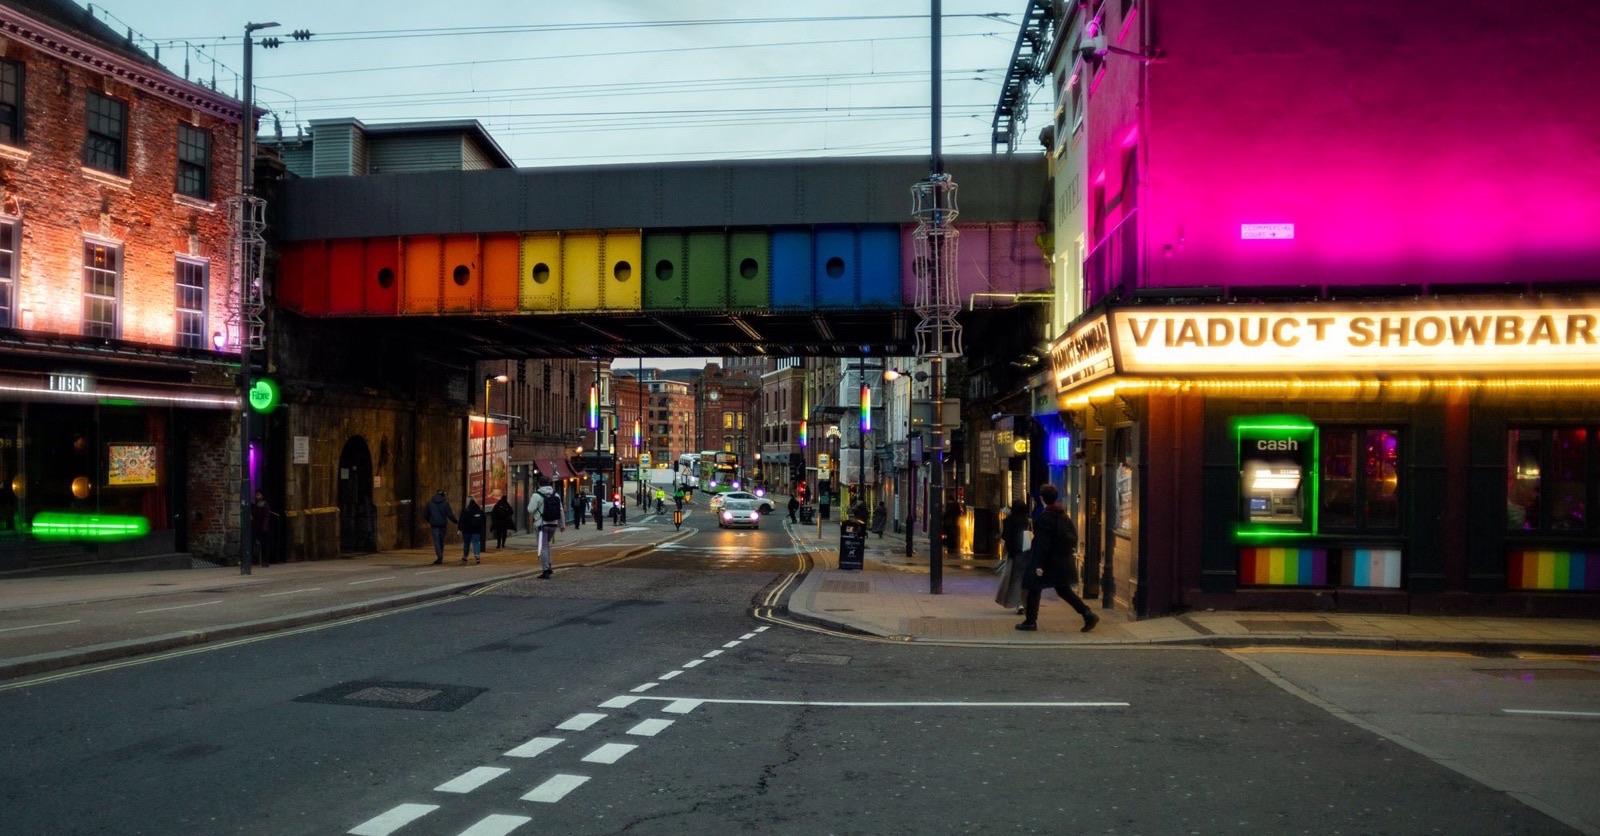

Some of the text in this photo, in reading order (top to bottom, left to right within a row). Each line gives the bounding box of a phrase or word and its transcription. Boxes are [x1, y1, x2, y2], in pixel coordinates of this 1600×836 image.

[1058, 173, 1081, 227] HOTEL
[1128, 314, 1598, 348] VIADUCT SHOWBAR
[251, 391, 270, 401] Fibre
[1257, 436, 1298, 451] cash
